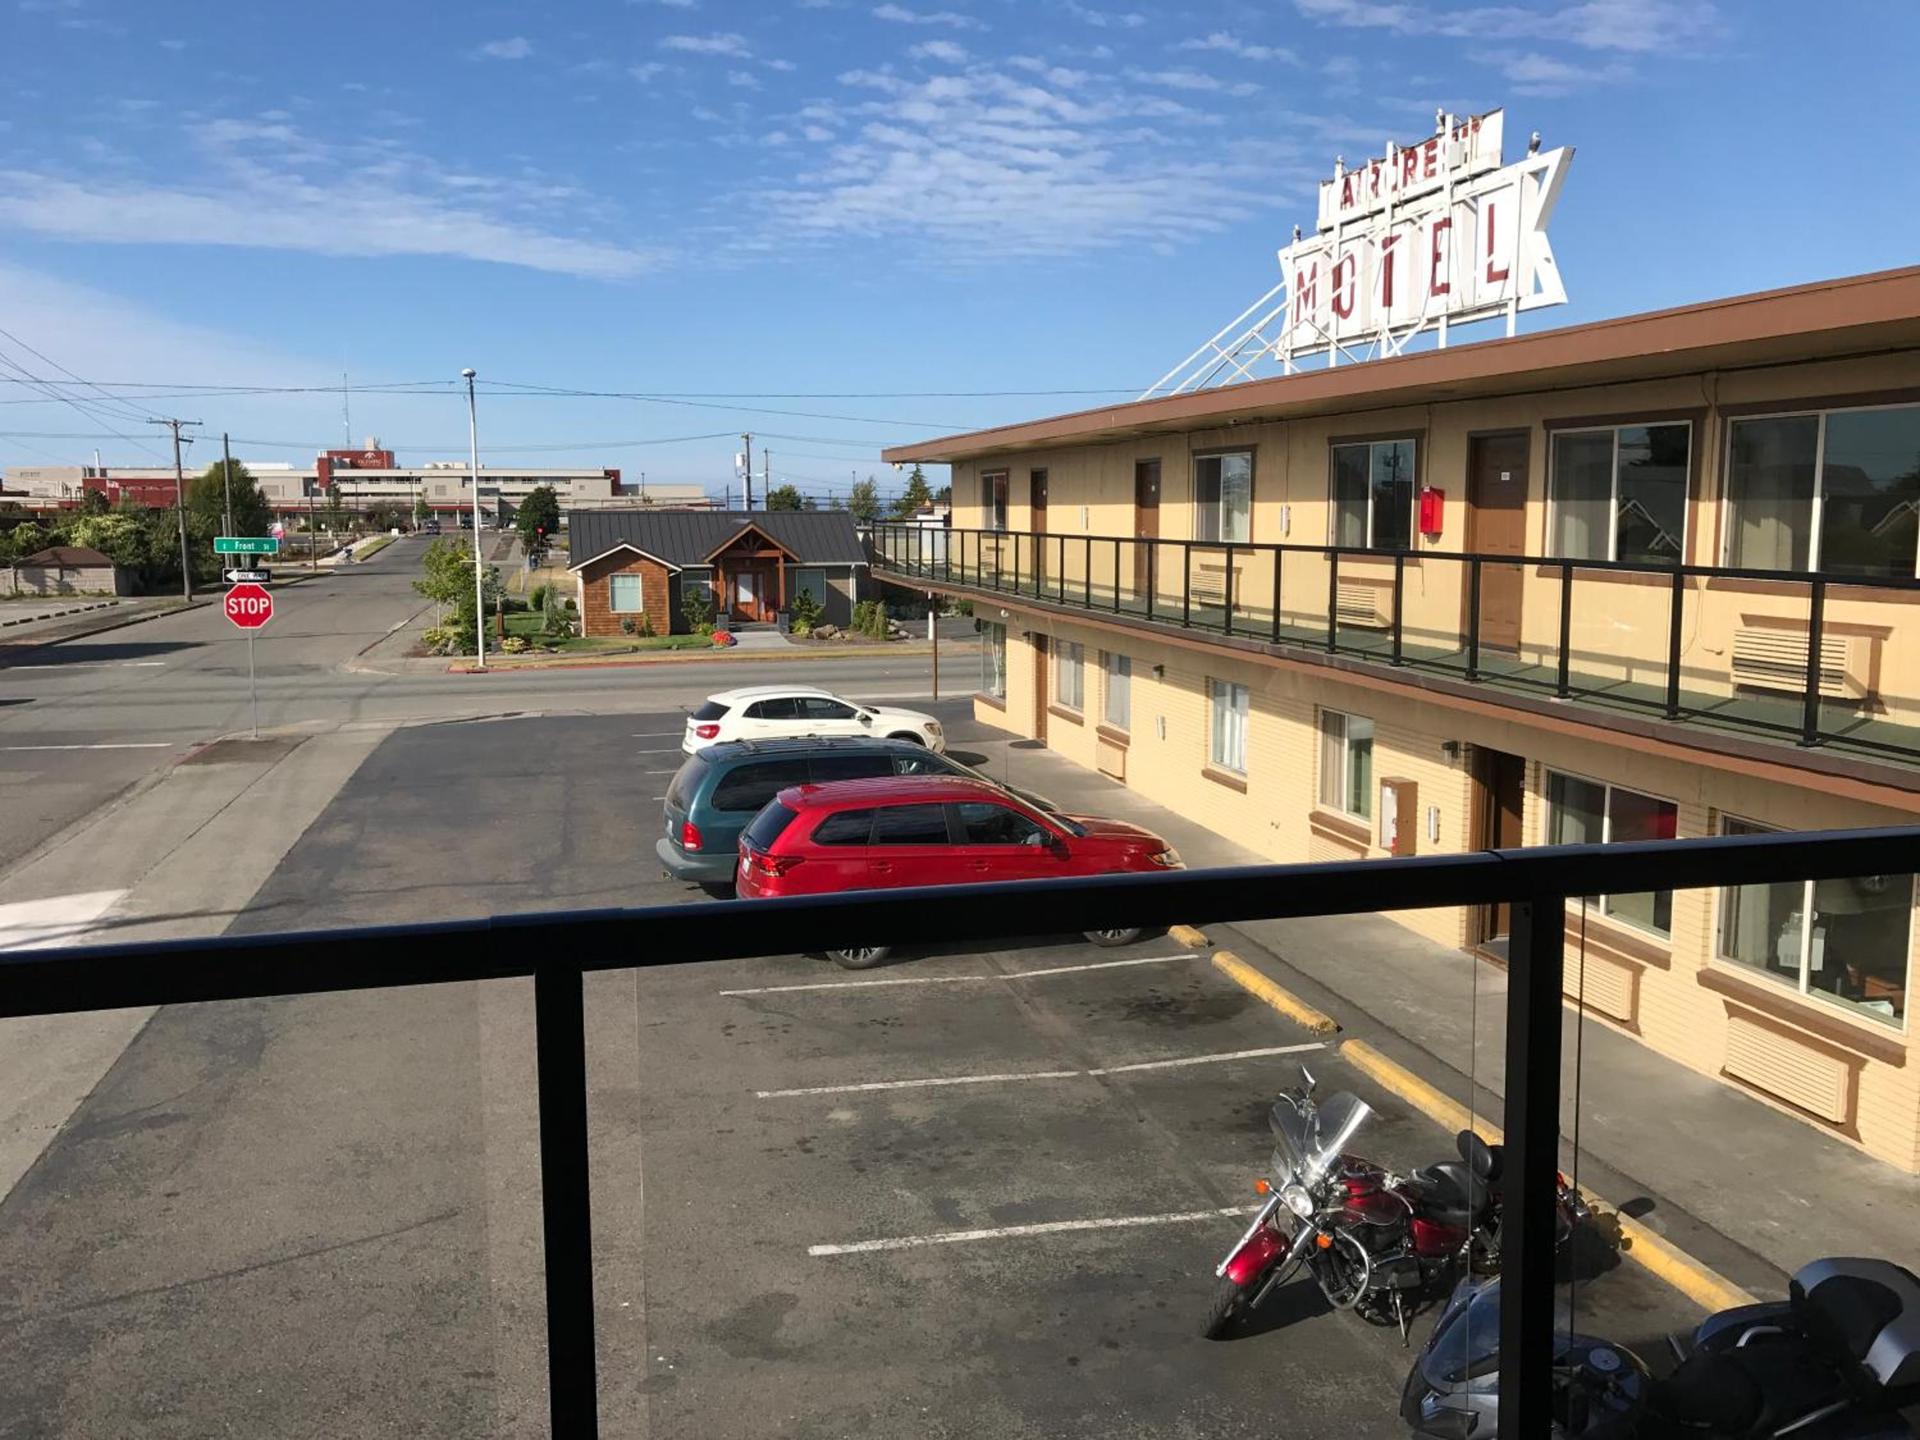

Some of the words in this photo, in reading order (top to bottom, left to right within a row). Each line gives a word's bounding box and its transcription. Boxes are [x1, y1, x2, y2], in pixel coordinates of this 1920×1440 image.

[1295, 202, 1509, 324] MOTEL
[234, 541, 255, 550] Front
[228, 597, 270, 615] STOP
